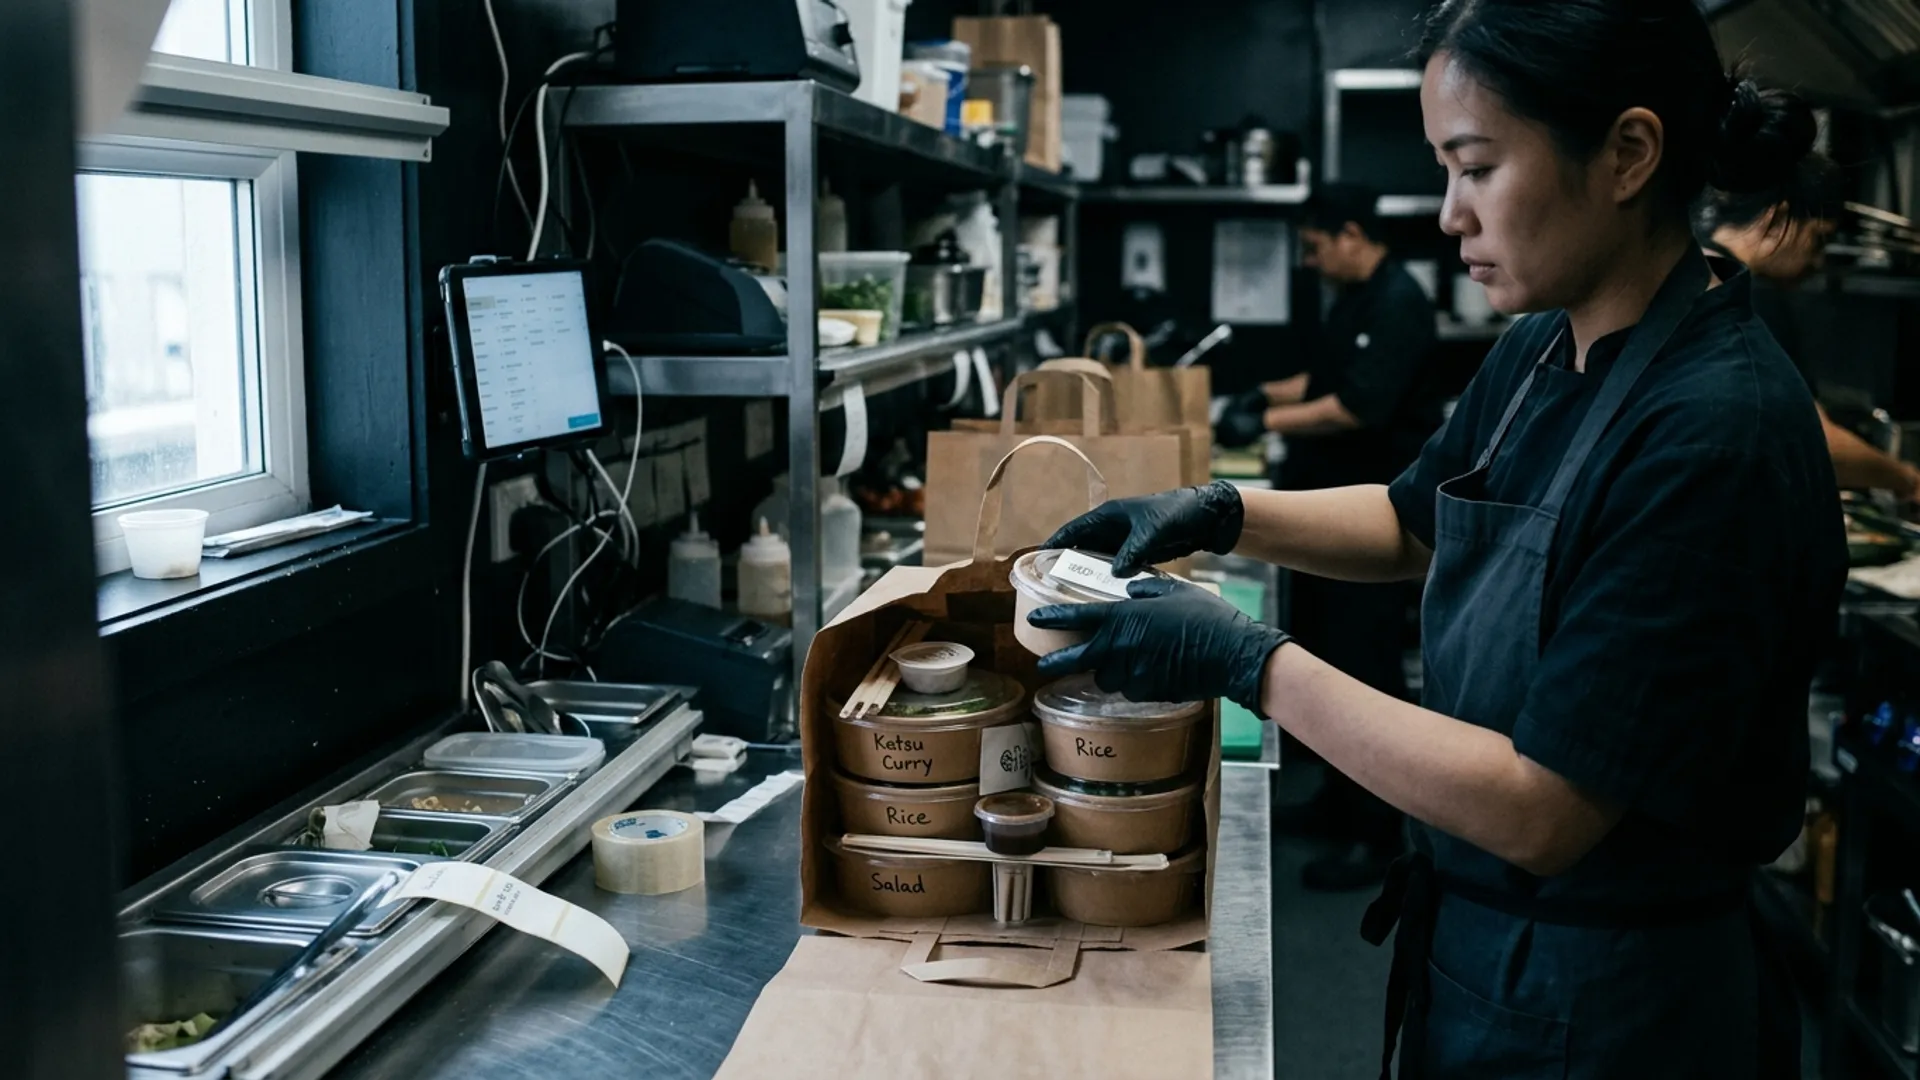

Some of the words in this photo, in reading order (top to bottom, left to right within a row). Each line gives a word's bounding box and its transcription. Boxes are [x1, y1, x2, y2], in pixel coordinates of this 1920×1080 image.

[1075, 737, 1117, 757] Rice
[882, 755, 933, 777] Curry
[886, 806, 932, 825] Rice
[871, 873, 926, 893] Salad
